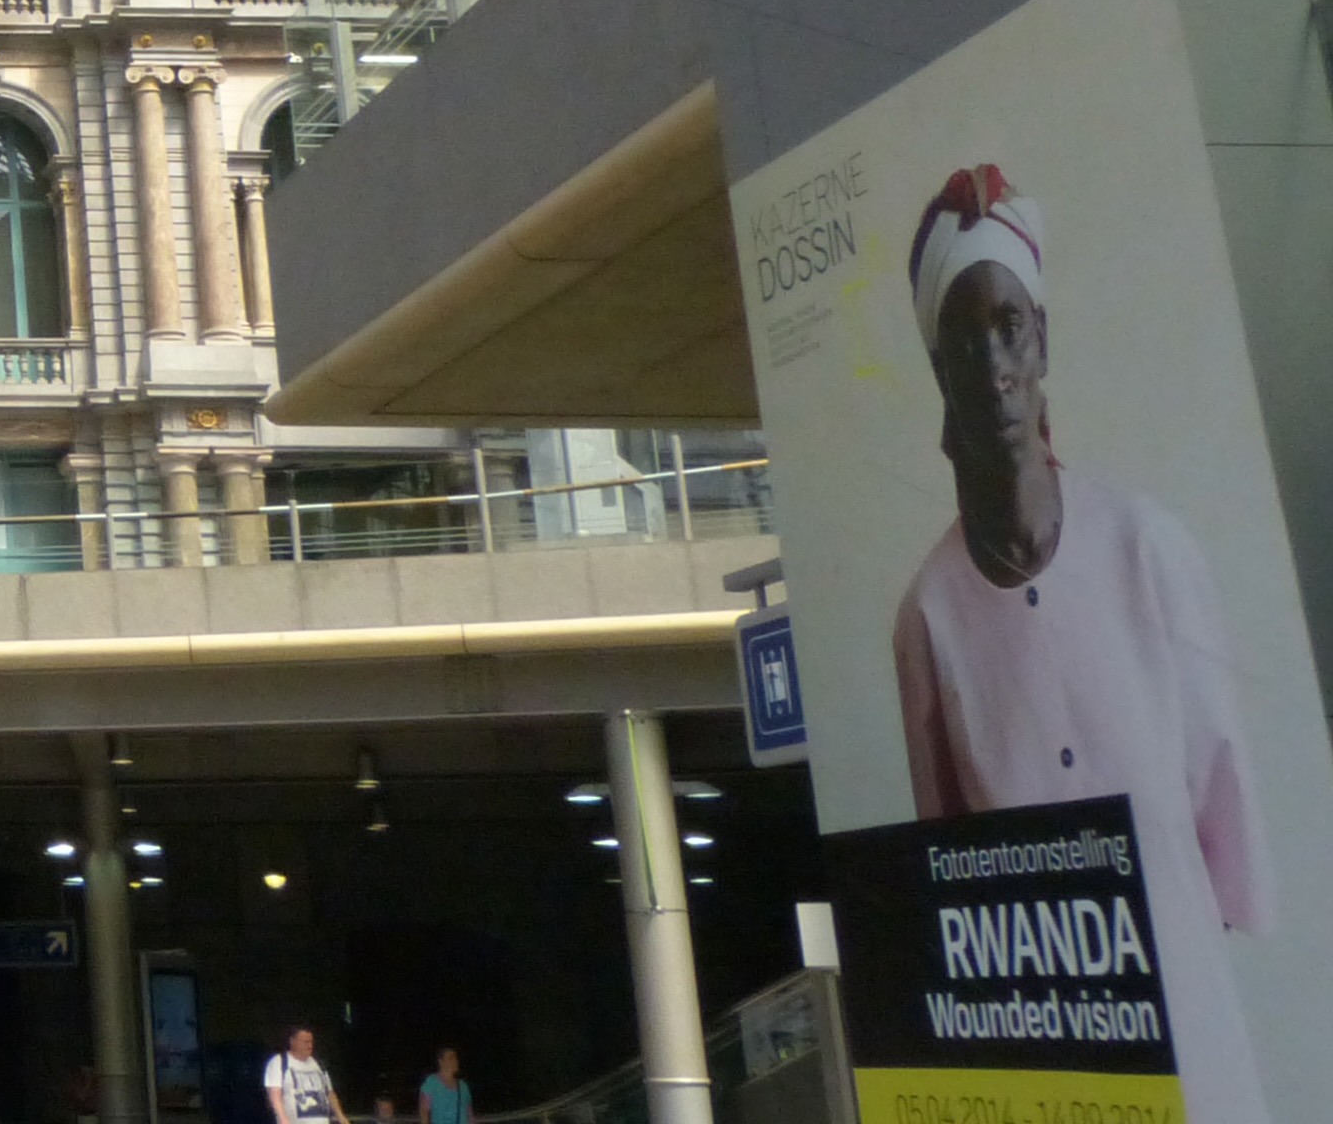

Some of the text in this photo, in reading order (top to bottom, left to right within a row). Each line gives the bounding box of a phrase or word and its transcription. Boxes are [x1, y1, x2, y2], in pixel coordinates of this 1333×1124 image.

[750, 152, 868, 248] KAZERNE
[757, 211, 856, 302] DOSSIN
[928, 829, 1132, 881] Fototentoonstelling
[939, 896, 1151, 979] RWANDA
[926, 989, 1161, 1041] Wounded vision
